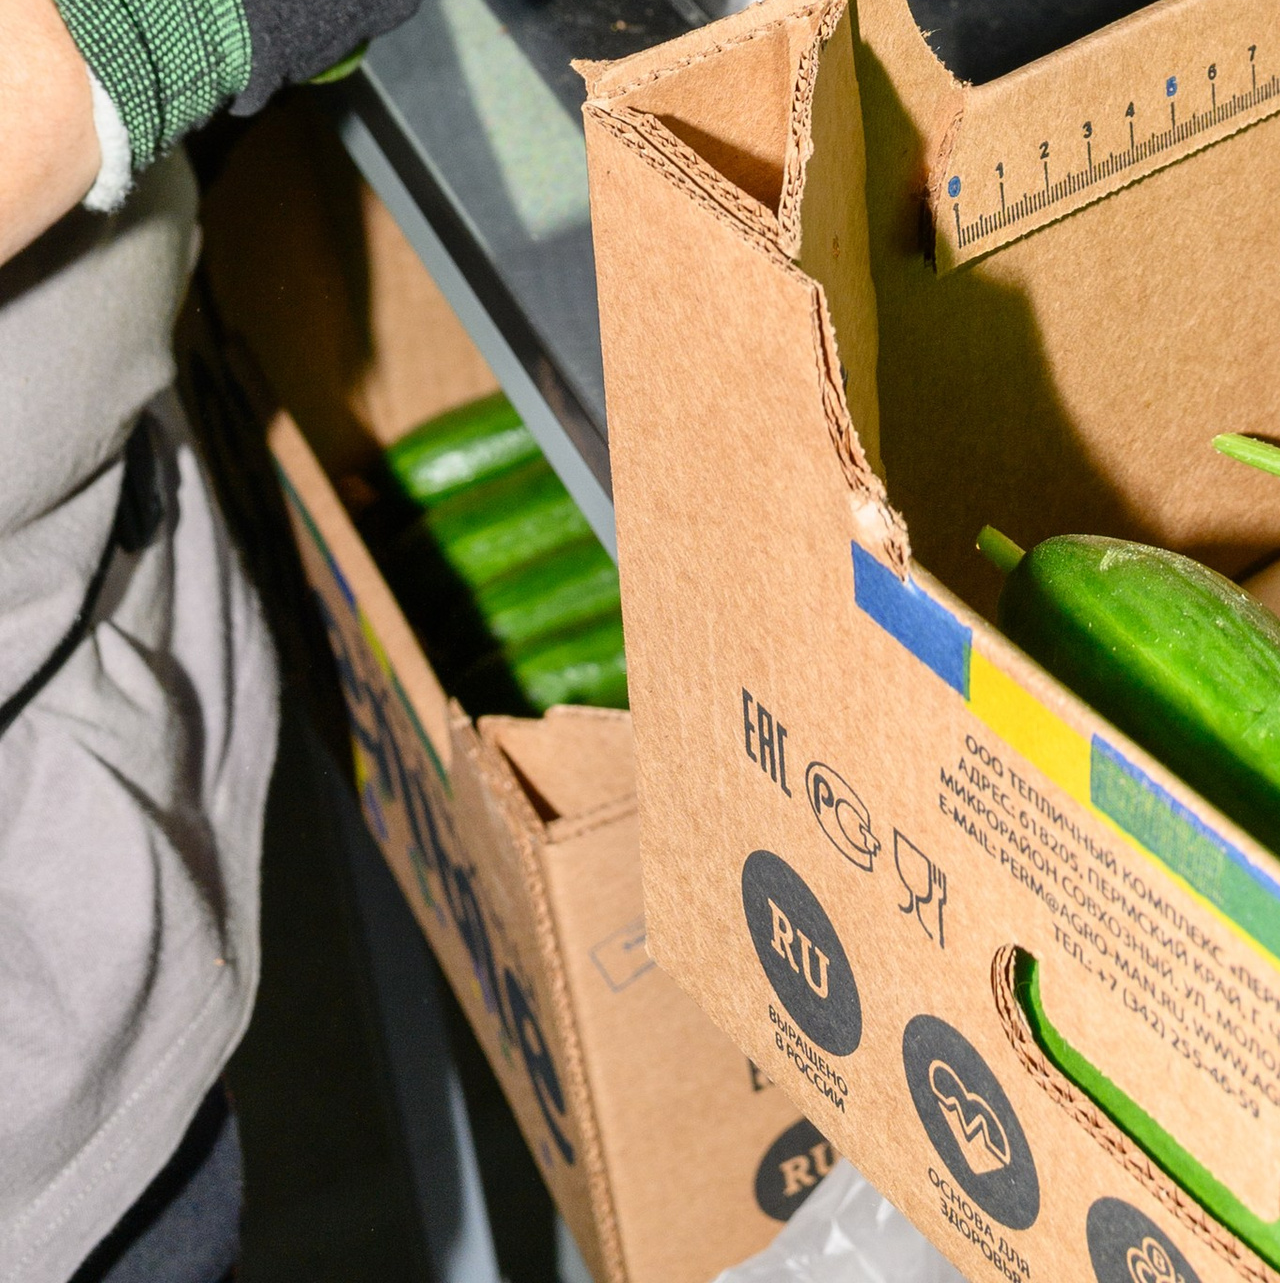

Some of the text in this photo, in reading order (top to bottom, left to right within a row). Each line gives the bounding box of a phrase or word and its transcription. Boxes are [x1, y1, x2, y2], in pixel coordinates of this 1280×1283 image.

[947, 175, 961, 198] 0
[995, 162, 1004, 179] 1
[1040, 141, 1050, 159] 2
[1083, 121, 1093, 139] 3
[1126, 102, 1135, 118] 4
[1166, 77, 1177, 97] 5
[1208, 64, 1217, 81] 6
[1247, 45, 1258, 62] 7
[939, 793, 997, 859] E-MAIL:
[965, 734, 1004, 778] ООО
[1008, 768, 1117, 876] ТЕПЛИЧНЫЙ
[1122, 865, 1224, 968] КОМПЛЕКС
[940, 767, 1058, 883] МИКРОРАЙОН
[1061, 876, 1179, 992] СОВХОЗНЫЙ,
[1182, 977, 1211, 1019] УЛ.
[958, 756, 1015, 819] АДРЕС:
[1019, 810, 1084, 880] 618205,
[1088, 867, 1188, 966] ПЕРМСКИЙ
[1194, 957, 1246, 1020] КРАЙ,
[767, 897, 830, 999] RU
[768, 1004, 849, 1096] ВЫРАЩЕНО
[775, 1031, 845, 1113] В РОССИИ
[1097, 968, 1118, 992] +7
[1122, 987, 1166, 1040] (342)
[1170, 1027, 1260, 1119] 255-46-59
[928, 1167, 1031, 1279] ОСНОВА ДЛЯ
[939, 1196, 1022, 1283] ЗДОРОВЬЯ
